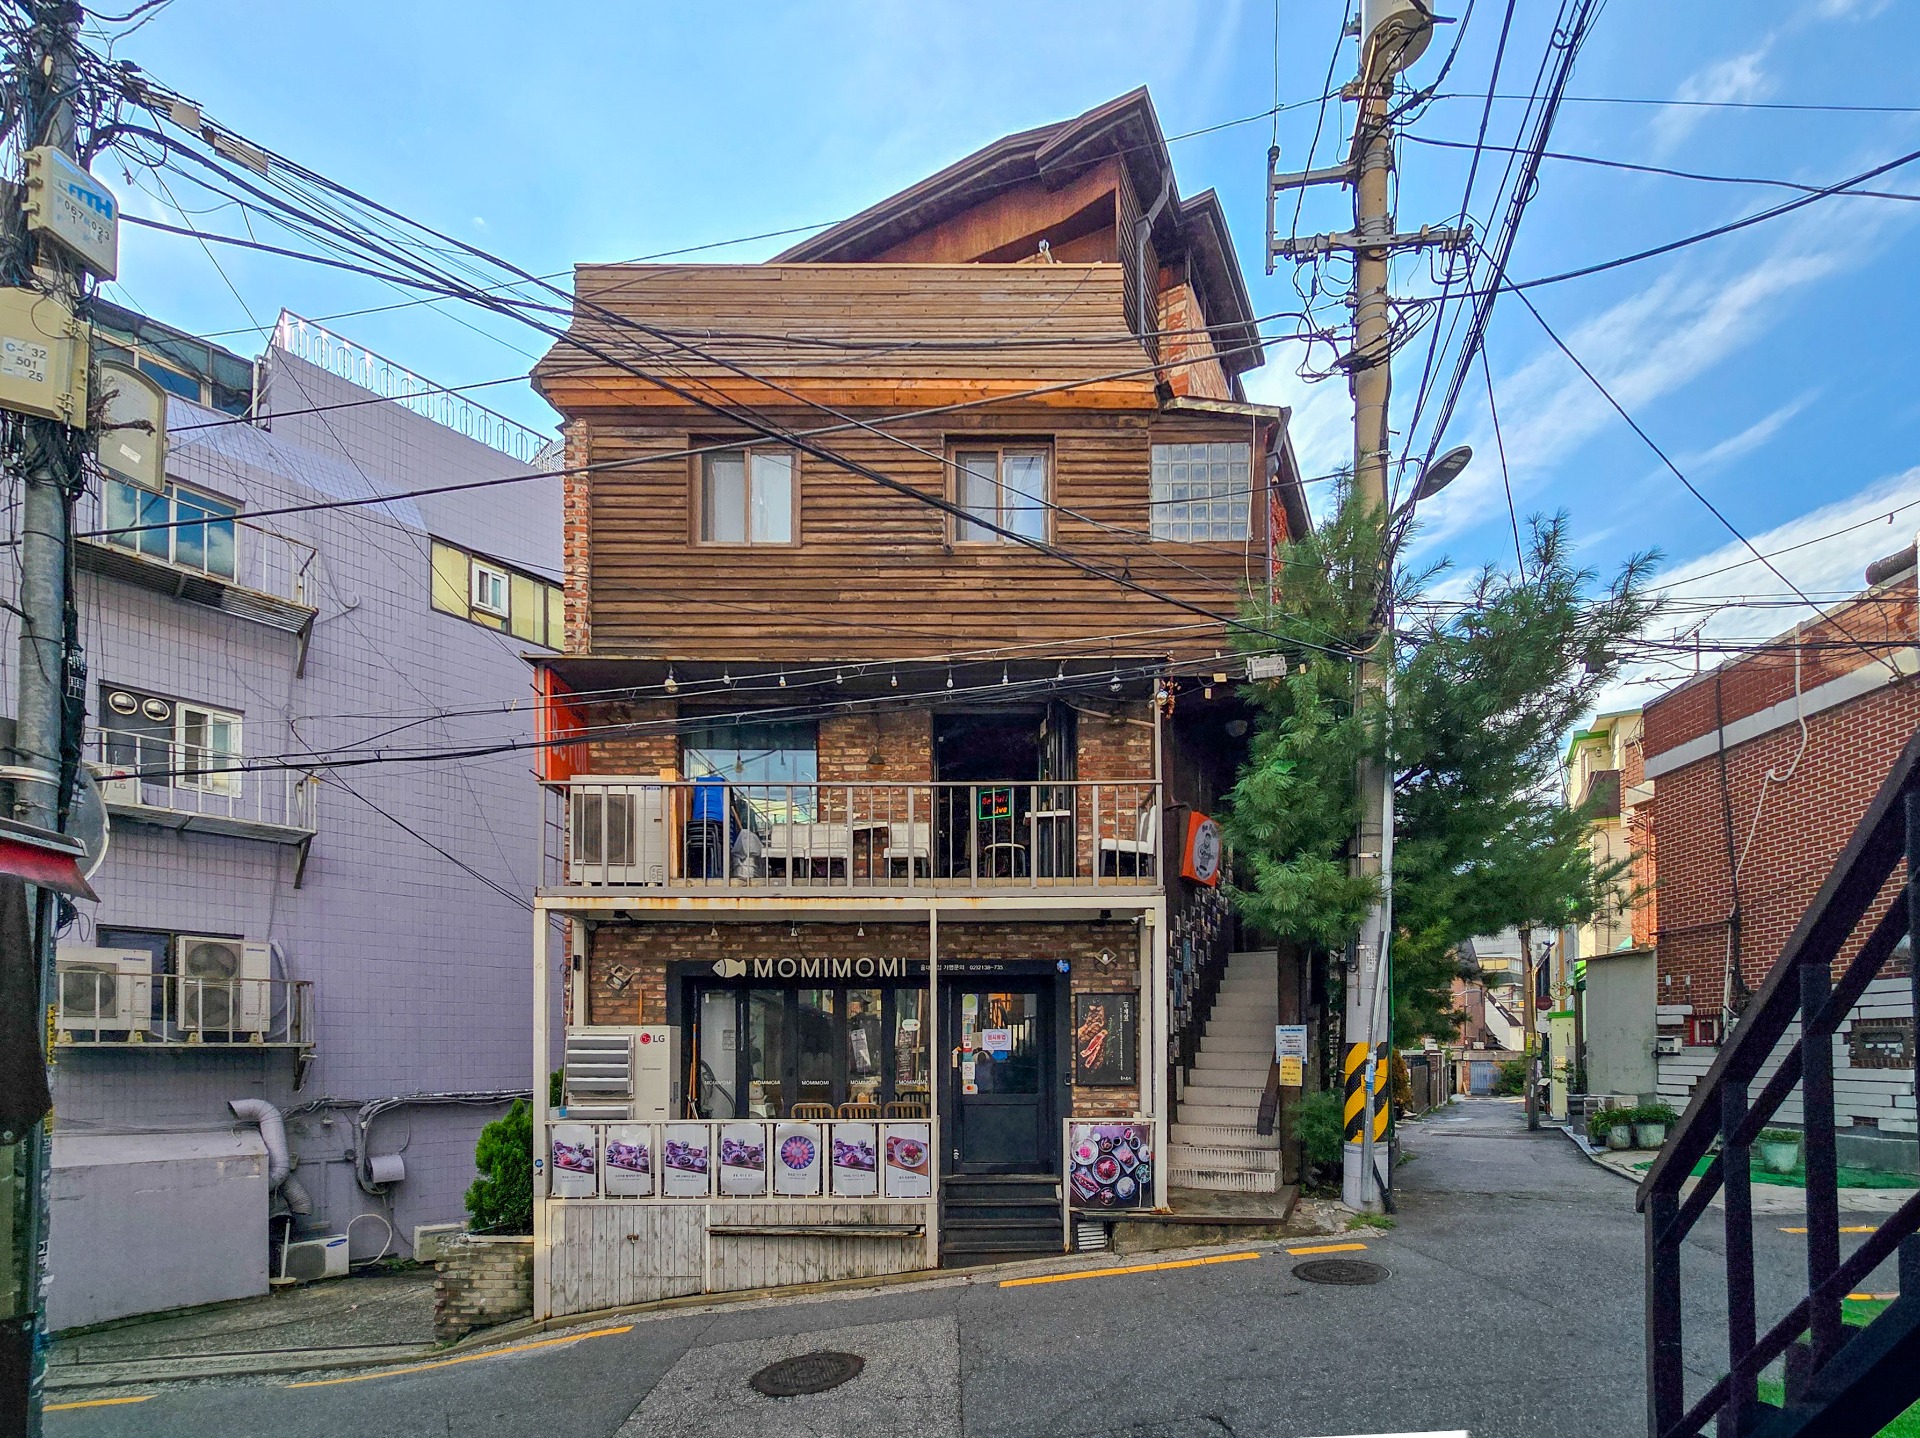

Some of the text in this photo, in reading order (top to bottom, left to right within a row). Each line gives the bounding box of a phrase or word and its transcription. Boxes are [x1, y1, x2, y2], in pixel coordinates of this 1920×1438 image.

[67, 183, 113, 221] FTTH
[64, 200, 110, 240] 067 023
[31, 348, 47, 360] 32
[16, 356, 37, 369] 501
[28, 370, 43, 382] 25
[114, 782, 127, 790] LG
[754, 956, 907, 978] MOMIMOMI
[653, 1034, 666, 1043] LG
